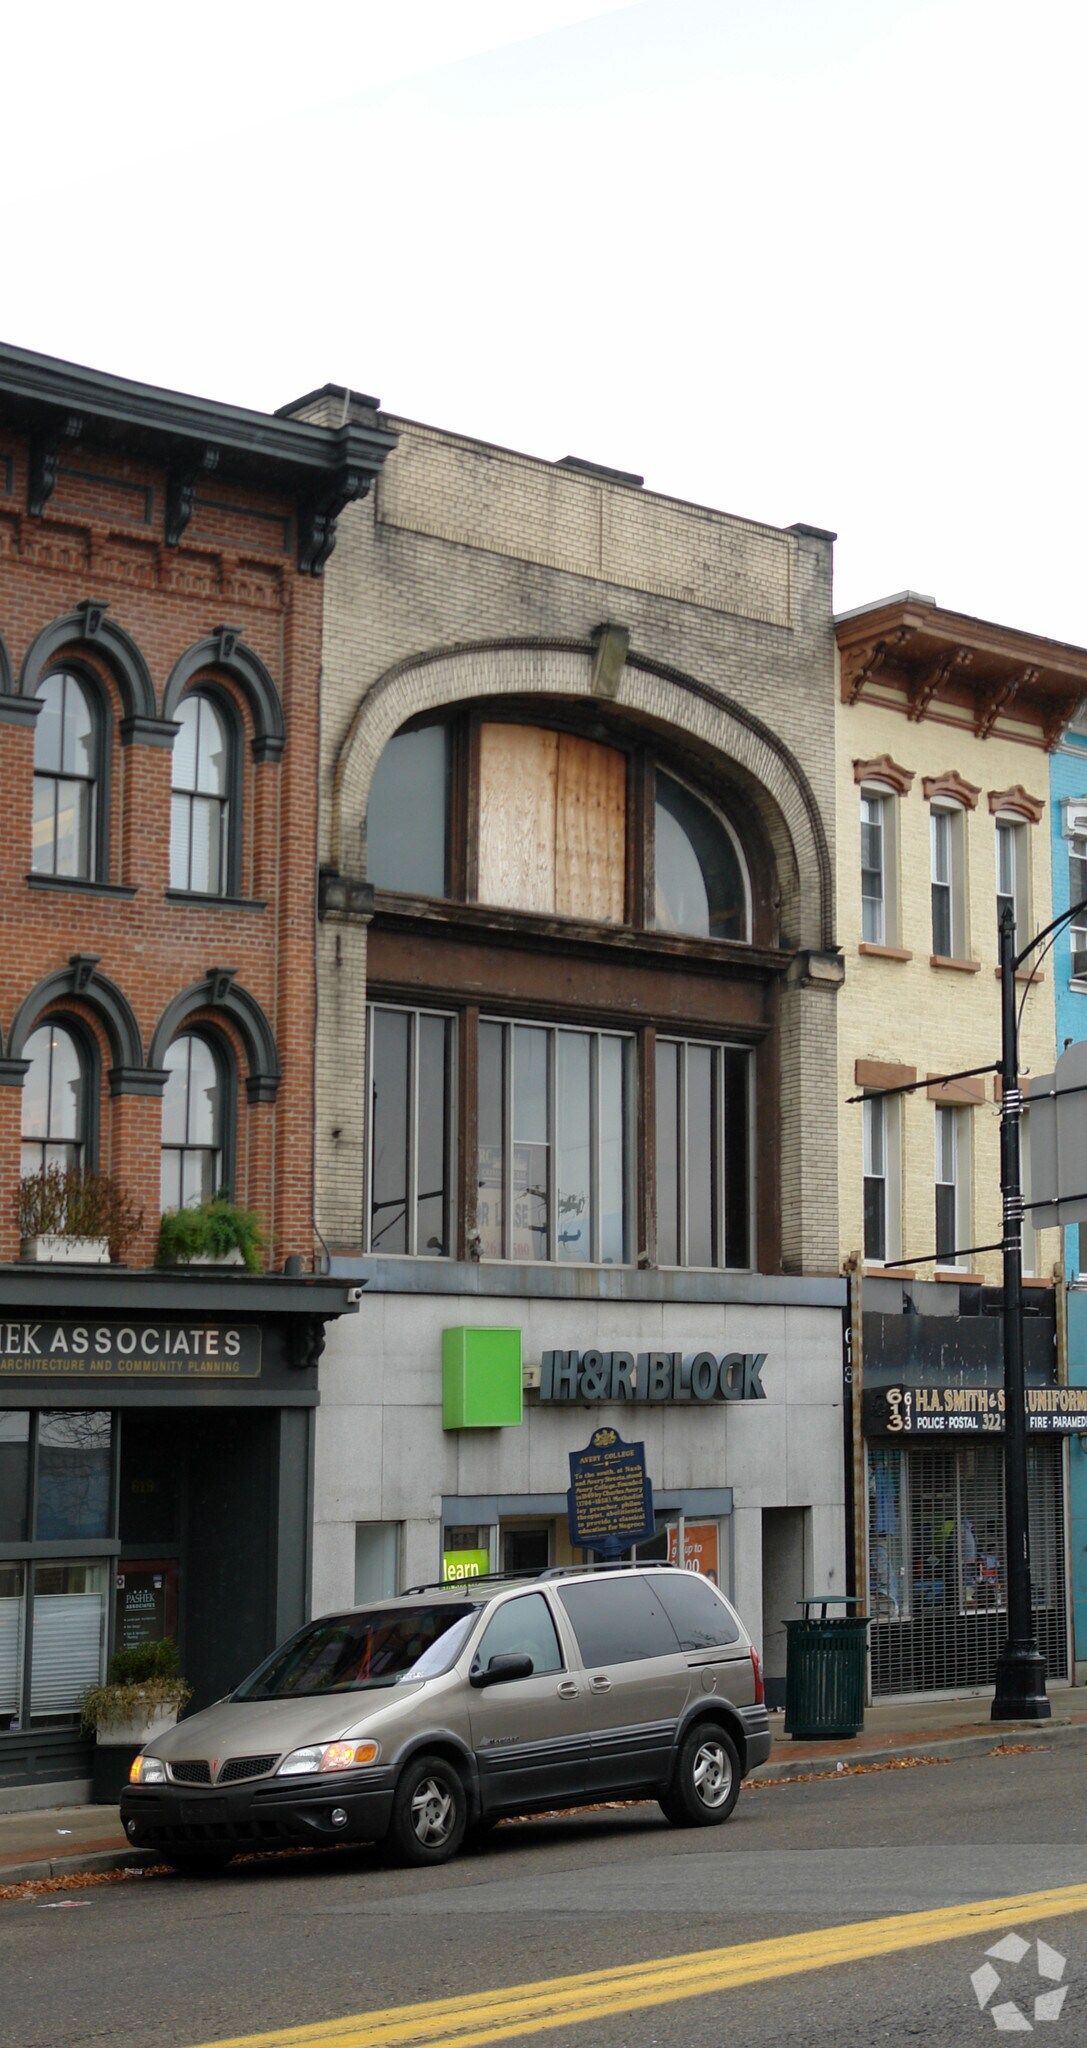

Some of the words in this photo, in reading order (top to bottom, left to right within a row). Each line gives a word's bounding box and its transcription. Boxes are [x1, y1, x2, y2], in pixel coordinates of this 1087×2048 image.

[49, 1327, 241, 1356] ASSOCIATES
[1, 1359, 85, 1371] ARCHITECTURE
[90, 1360, 113, 1371] AND
[117, 1360, 183, 1372] COMMUNITY
[188, 1361, 240, 1373] PLANNING
[540, 1350, 634, 1399] H&R
[637, 1351, 768, 1400] BLOCK
[943, 1388, 989, 1412] SMITH
[917, 1417, 945, 1429] POLICE
[948, 1416, 979, 1429] POSTAL
[1029, 1416, 1048, 1428] FIRE
[604, 1450, 635, 1460] COLLEGE
[694, 1543, 703, 1553] to
[443, 1559, 479, 1581] learn
[126, 1593, 156, 1603] PASHEK
